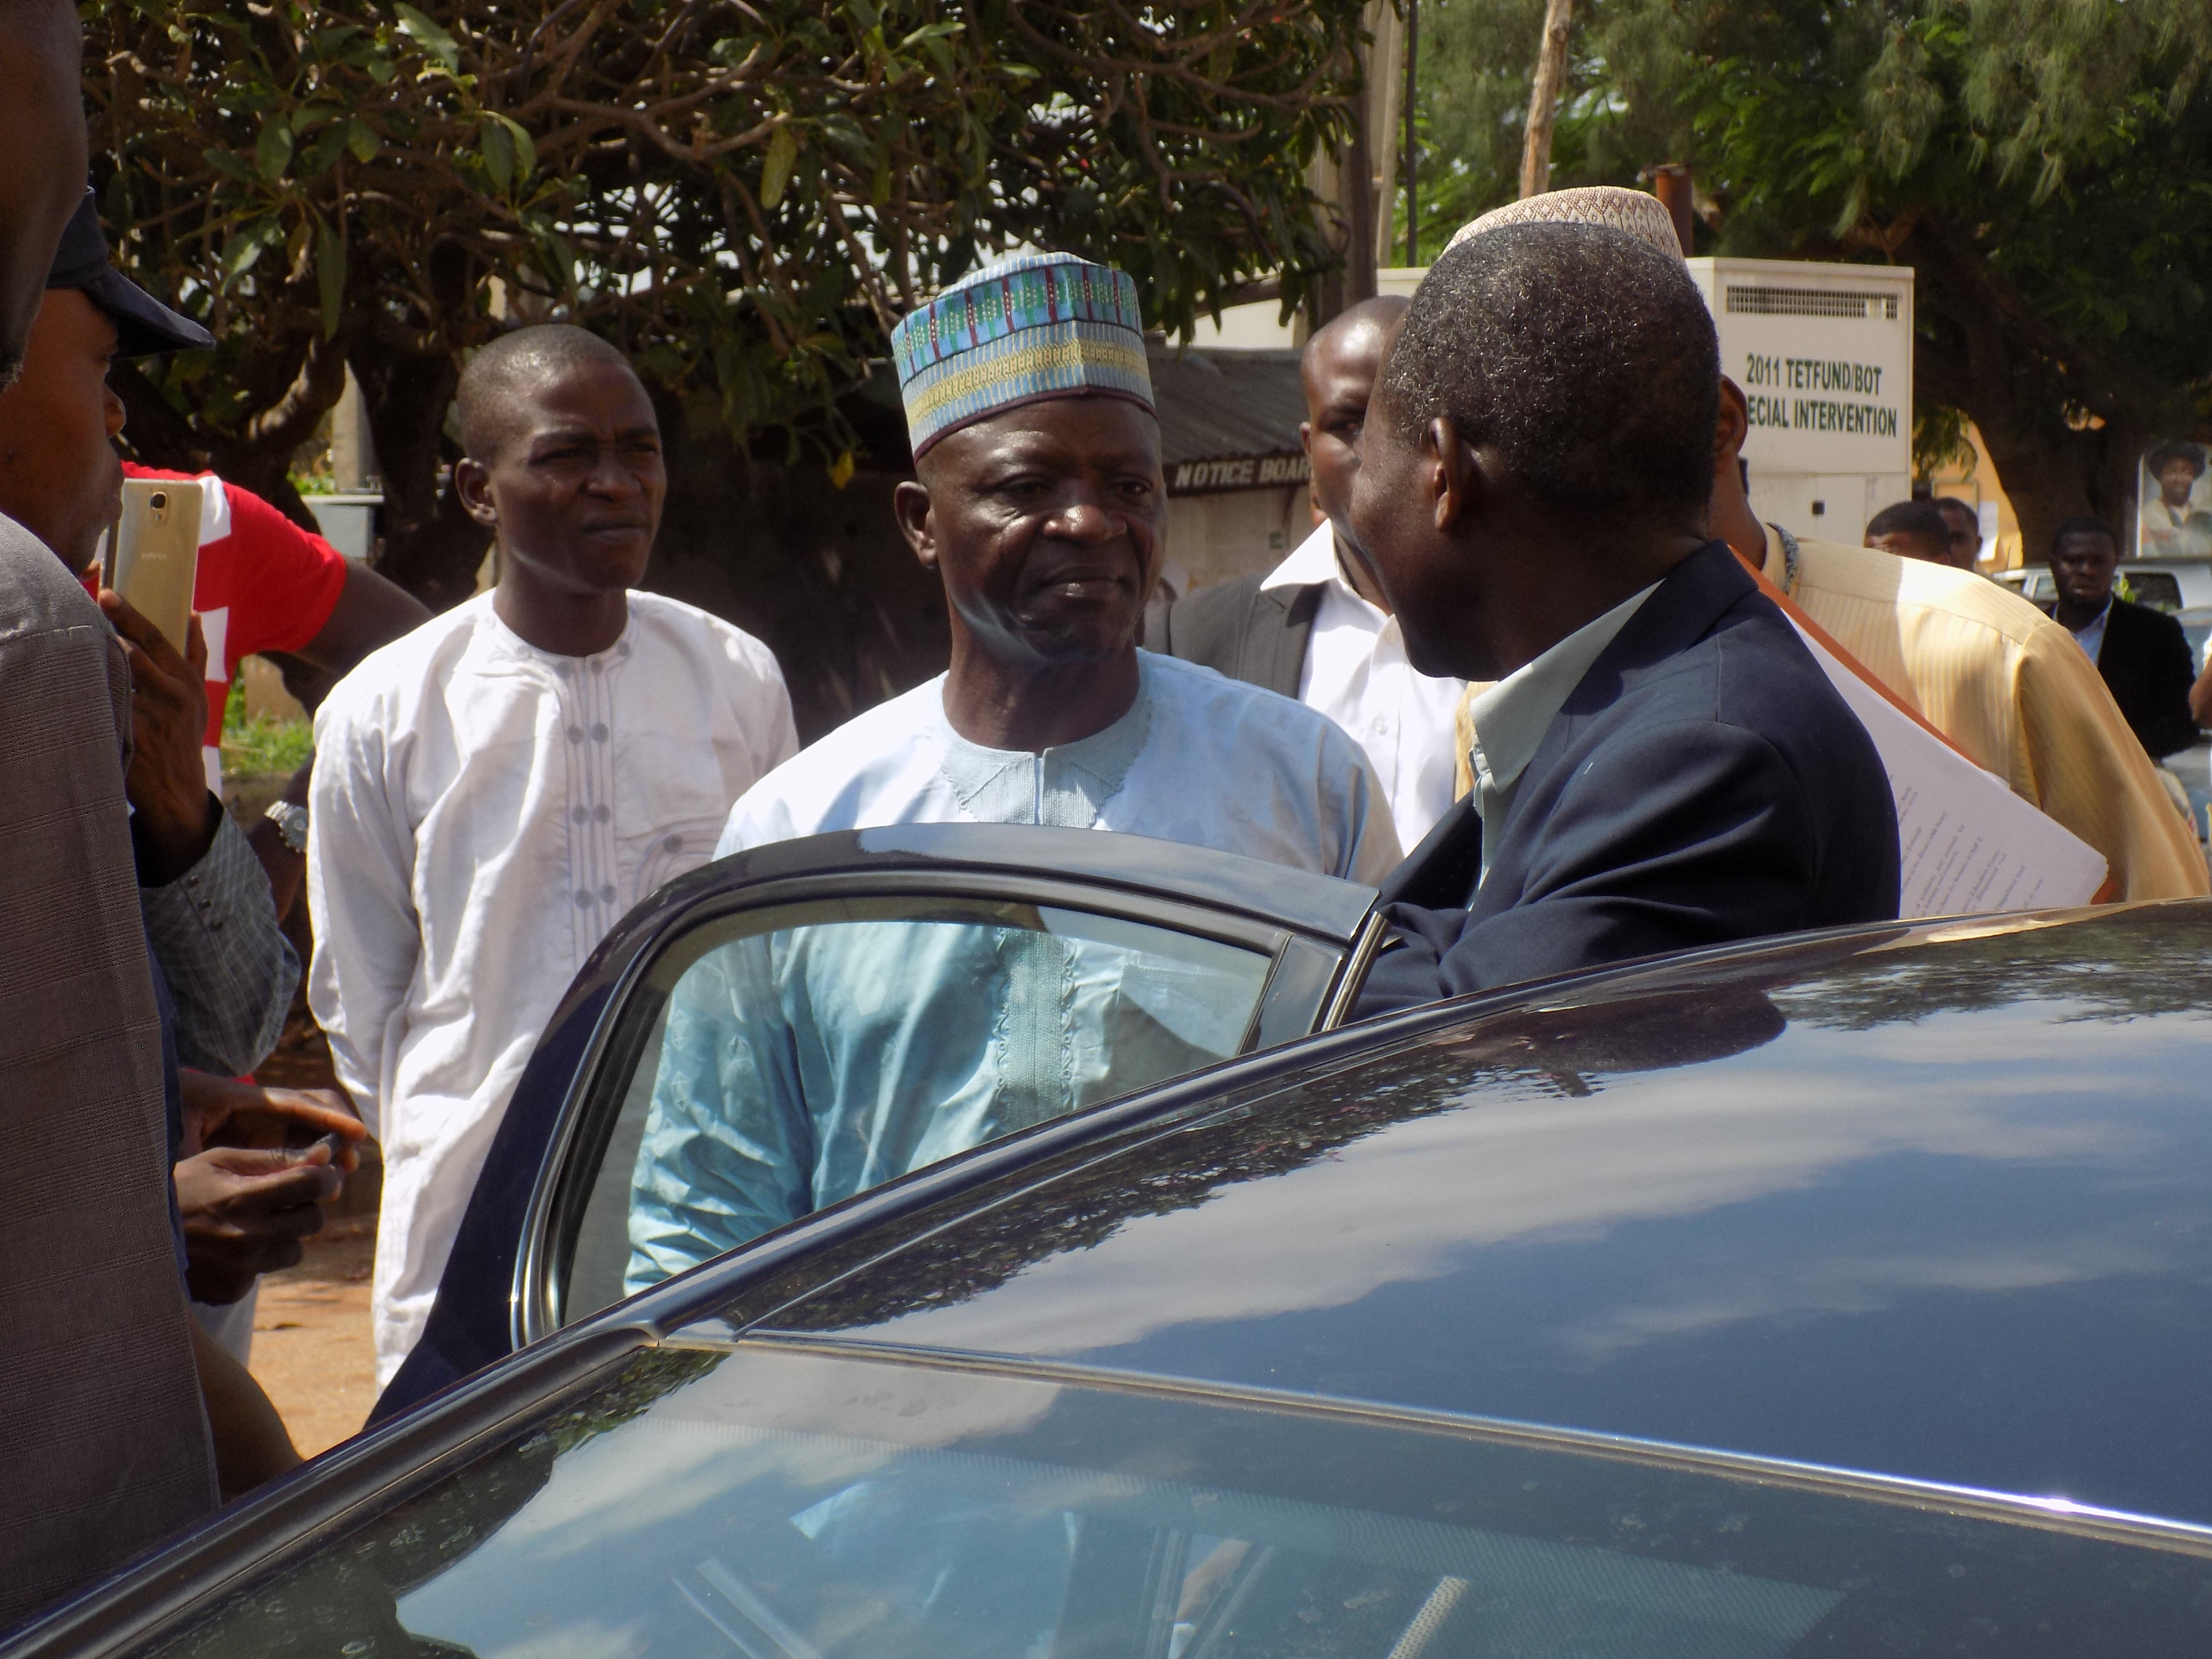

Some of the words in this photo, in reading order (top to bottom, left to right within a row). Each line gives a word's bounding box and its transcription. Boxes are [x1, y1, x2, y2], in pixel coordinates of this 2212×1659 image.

[1747, 352, 1780, 386] 2011
[1786, 357, 1882, 396] TETFUND/BOT
[1794, 398, 1898, 438] INTERVENTION
[1175, 459, 1255, 489] NOTICE
